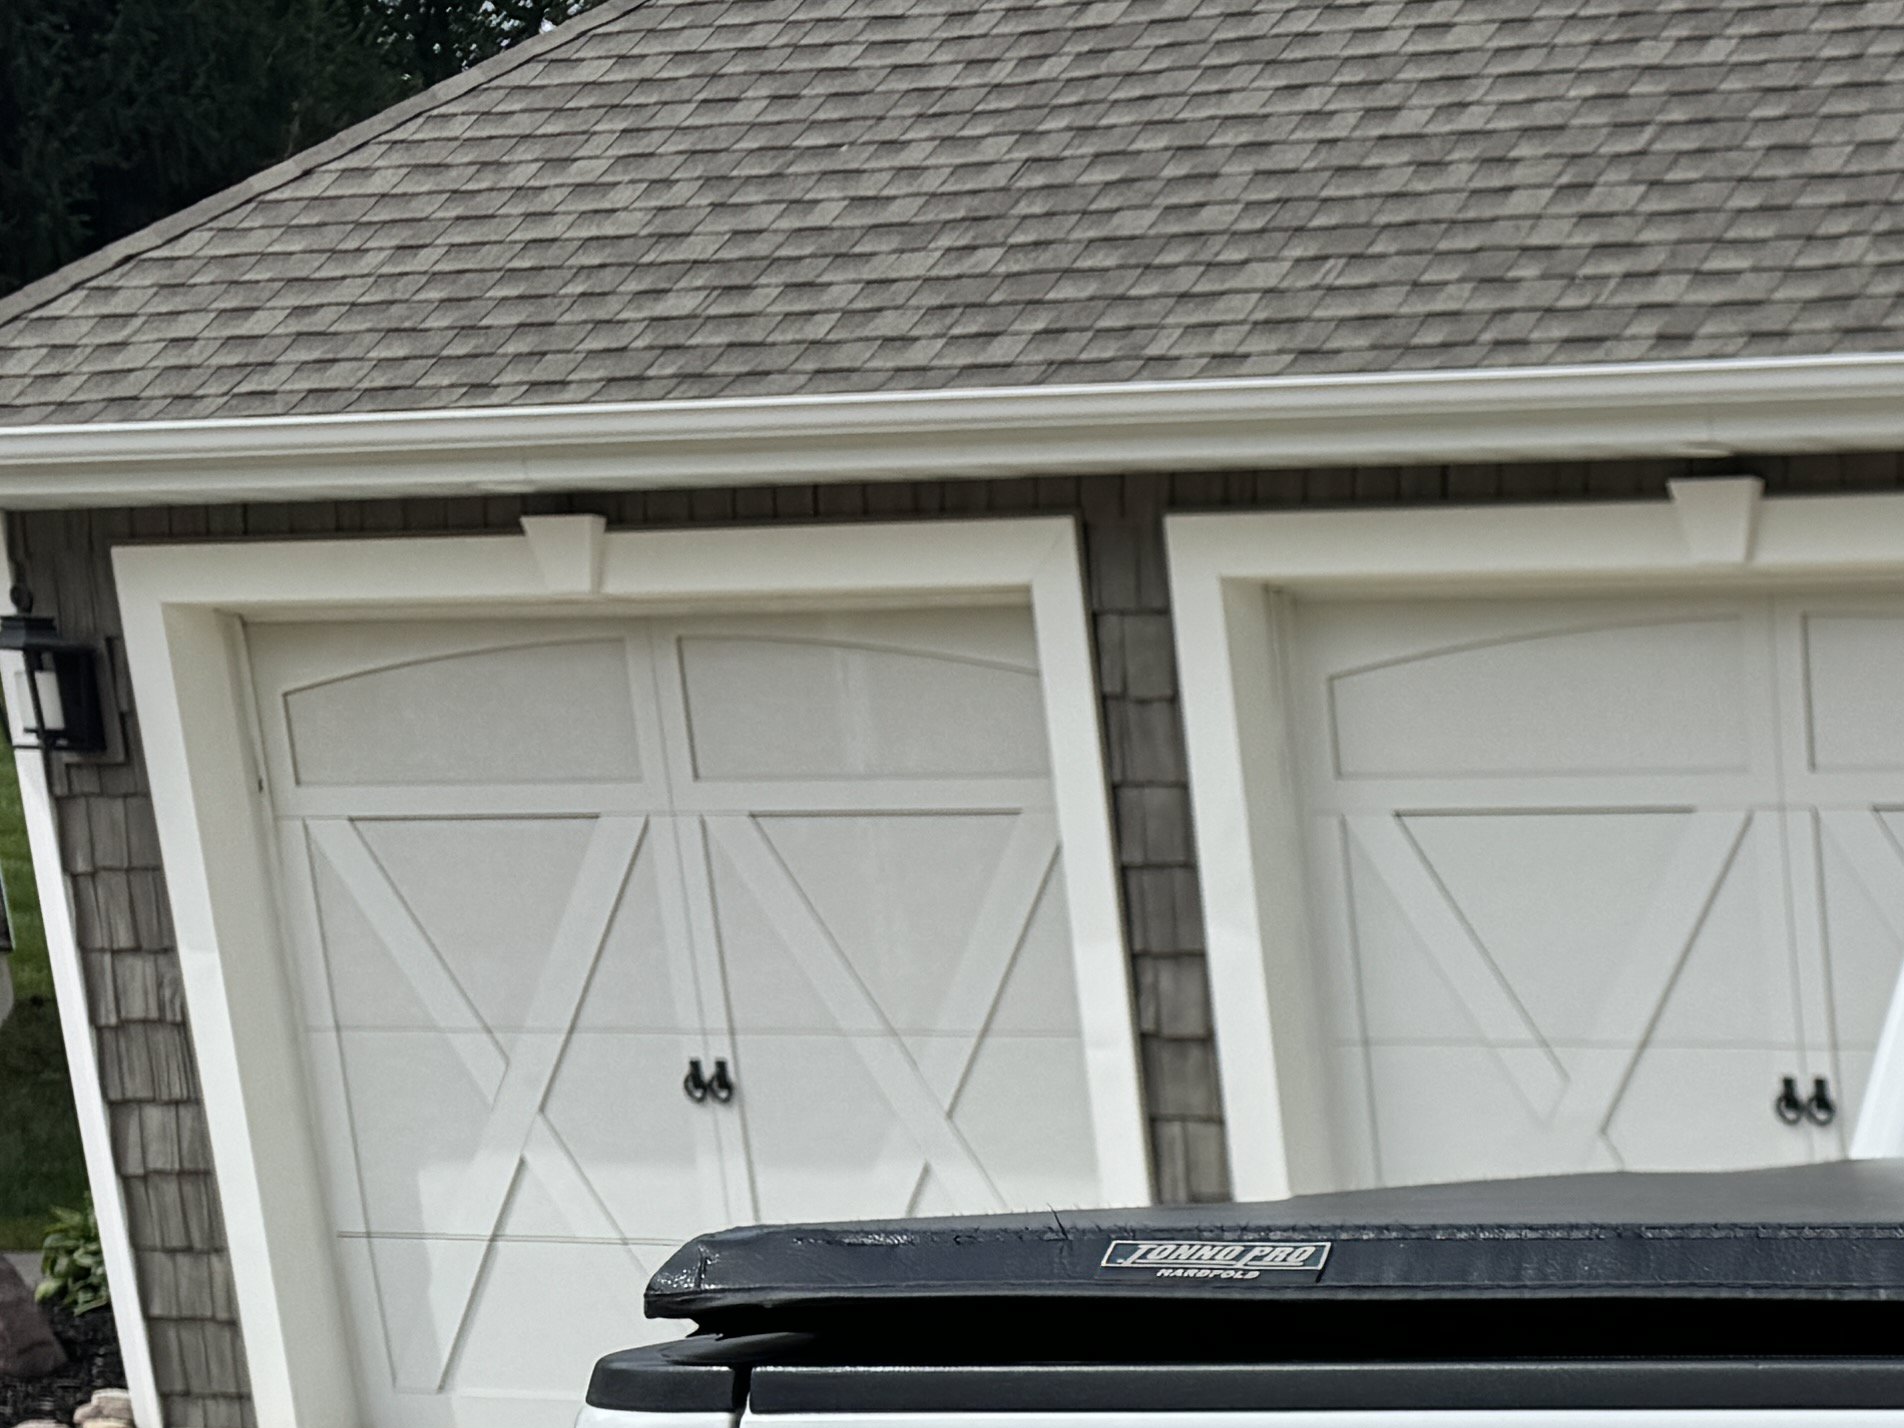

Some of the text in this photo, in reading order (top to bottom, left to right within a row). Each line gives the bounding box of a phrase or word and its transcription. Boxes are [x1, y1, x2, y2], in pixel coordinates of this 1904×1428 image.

[1116, 1244, 1316, 1268] TONNO PRO
[1155, 1268, 1261, 1280] HARDFOLD
